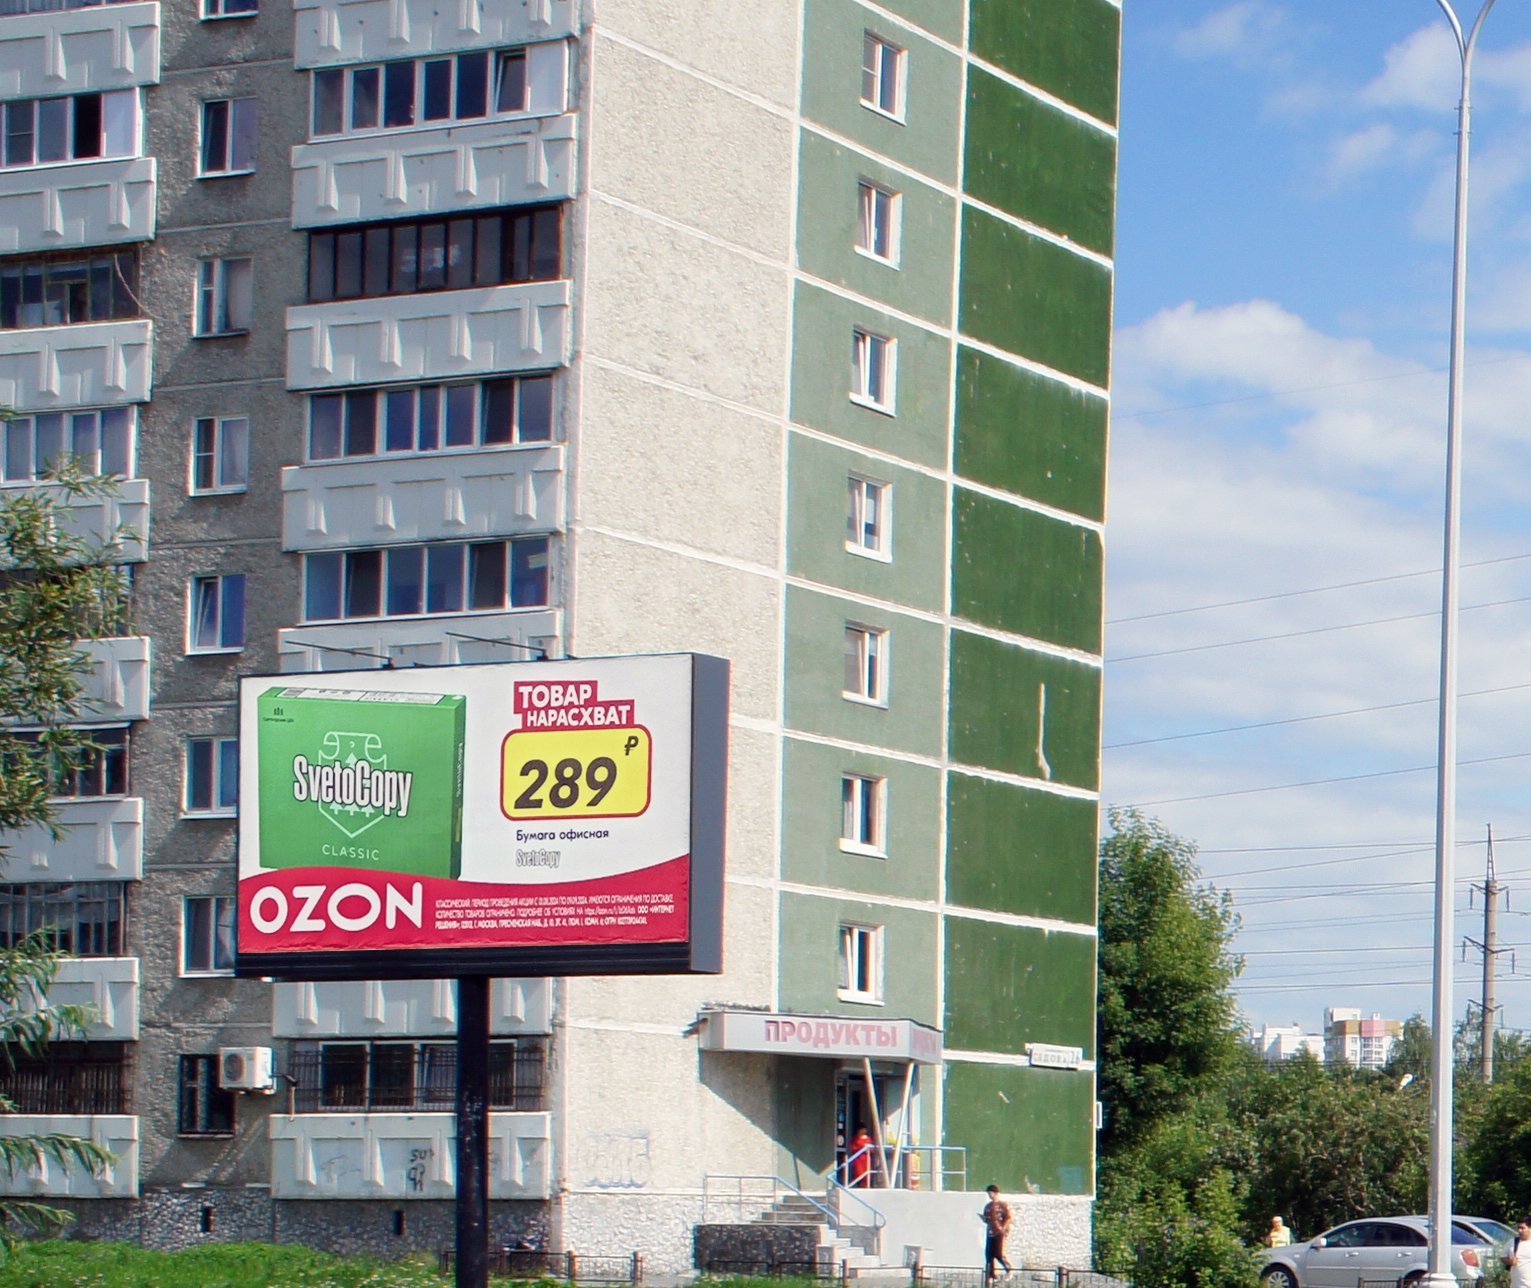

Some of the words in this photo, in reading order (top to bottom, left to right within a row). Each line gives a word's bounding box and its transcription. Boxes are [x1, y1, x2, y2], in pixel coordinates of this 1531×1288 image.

[518, 684, 592, 709] ТОВАР
[526, 705, 631, 727] НАРАСХВАТ
[292, 753, 413, 818] SvetoCopy
[514, 756, 617, 810] 289
[516, 829, 556, 844] Бумага
[560, 827, 610, 843] офисная
[321, 843, 380, 861] CLASSIC
[249, 881, 423, 934] OZON
[764, 1019, 897, 1049] ПРОДУКТЫ
